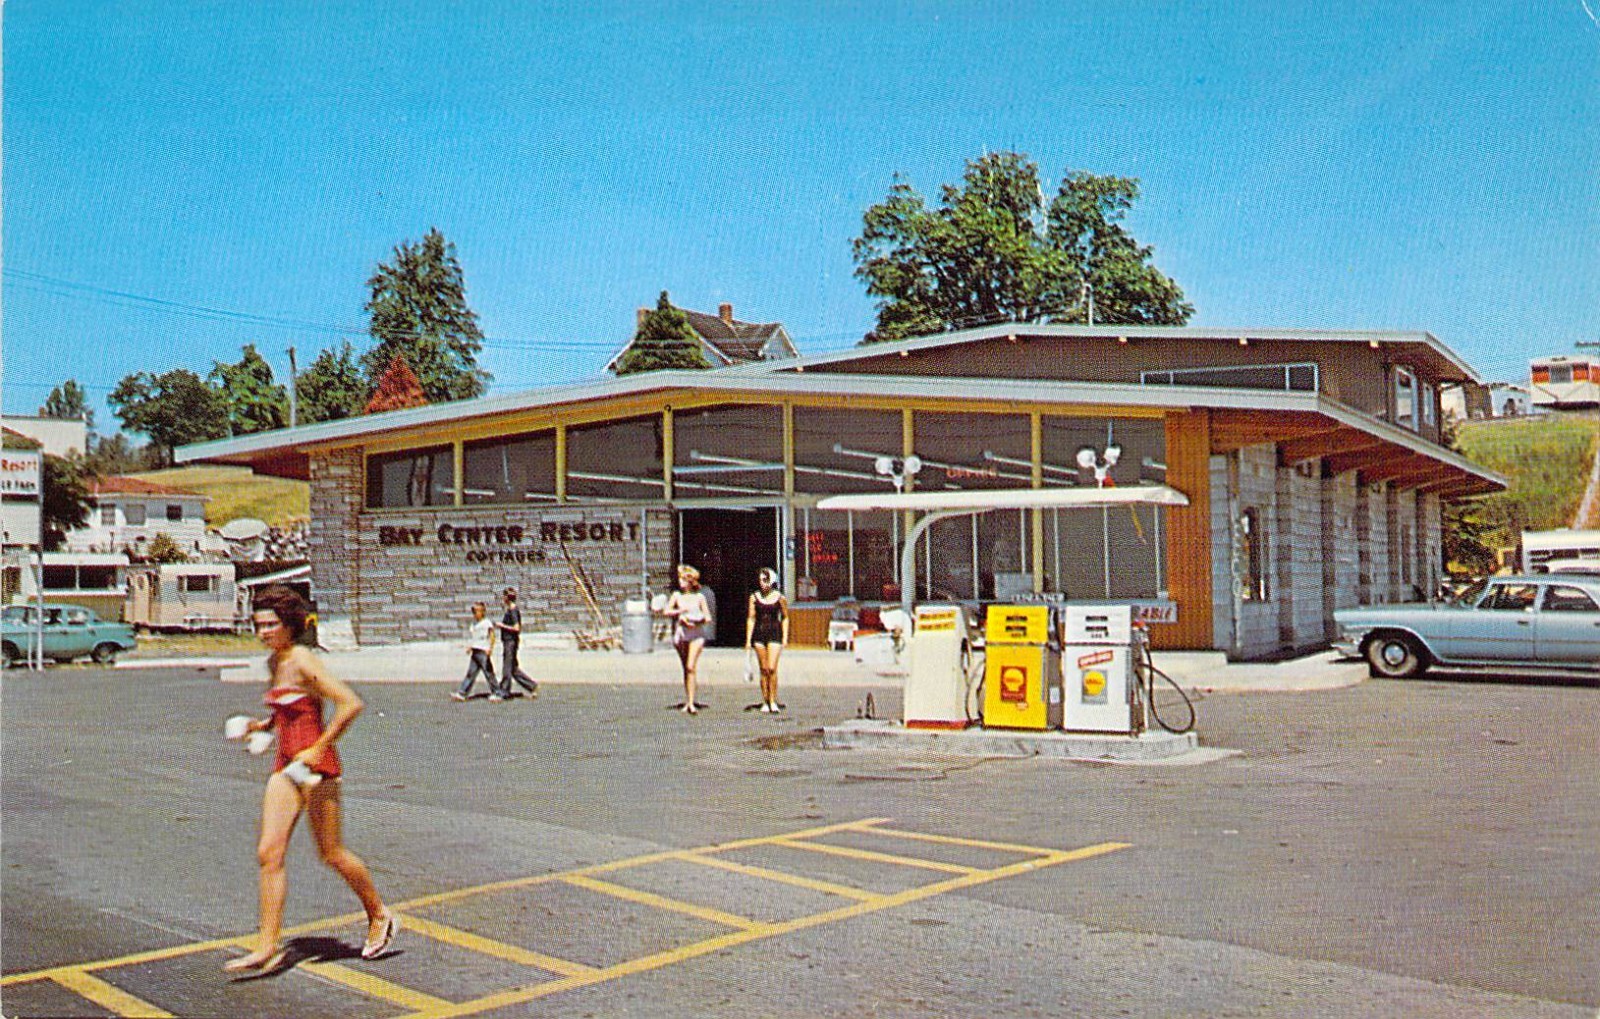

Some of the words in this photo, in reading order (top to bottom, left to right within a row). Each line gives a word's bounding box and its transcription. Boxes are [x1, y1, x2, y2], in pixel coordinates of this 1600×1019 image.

[379, 525, 424, 546] BAY
[437, 524, 524, 545] CENTER
[540, 522, 639, 543] RESORT
[466, 550, 546, 563] COTTAGES
